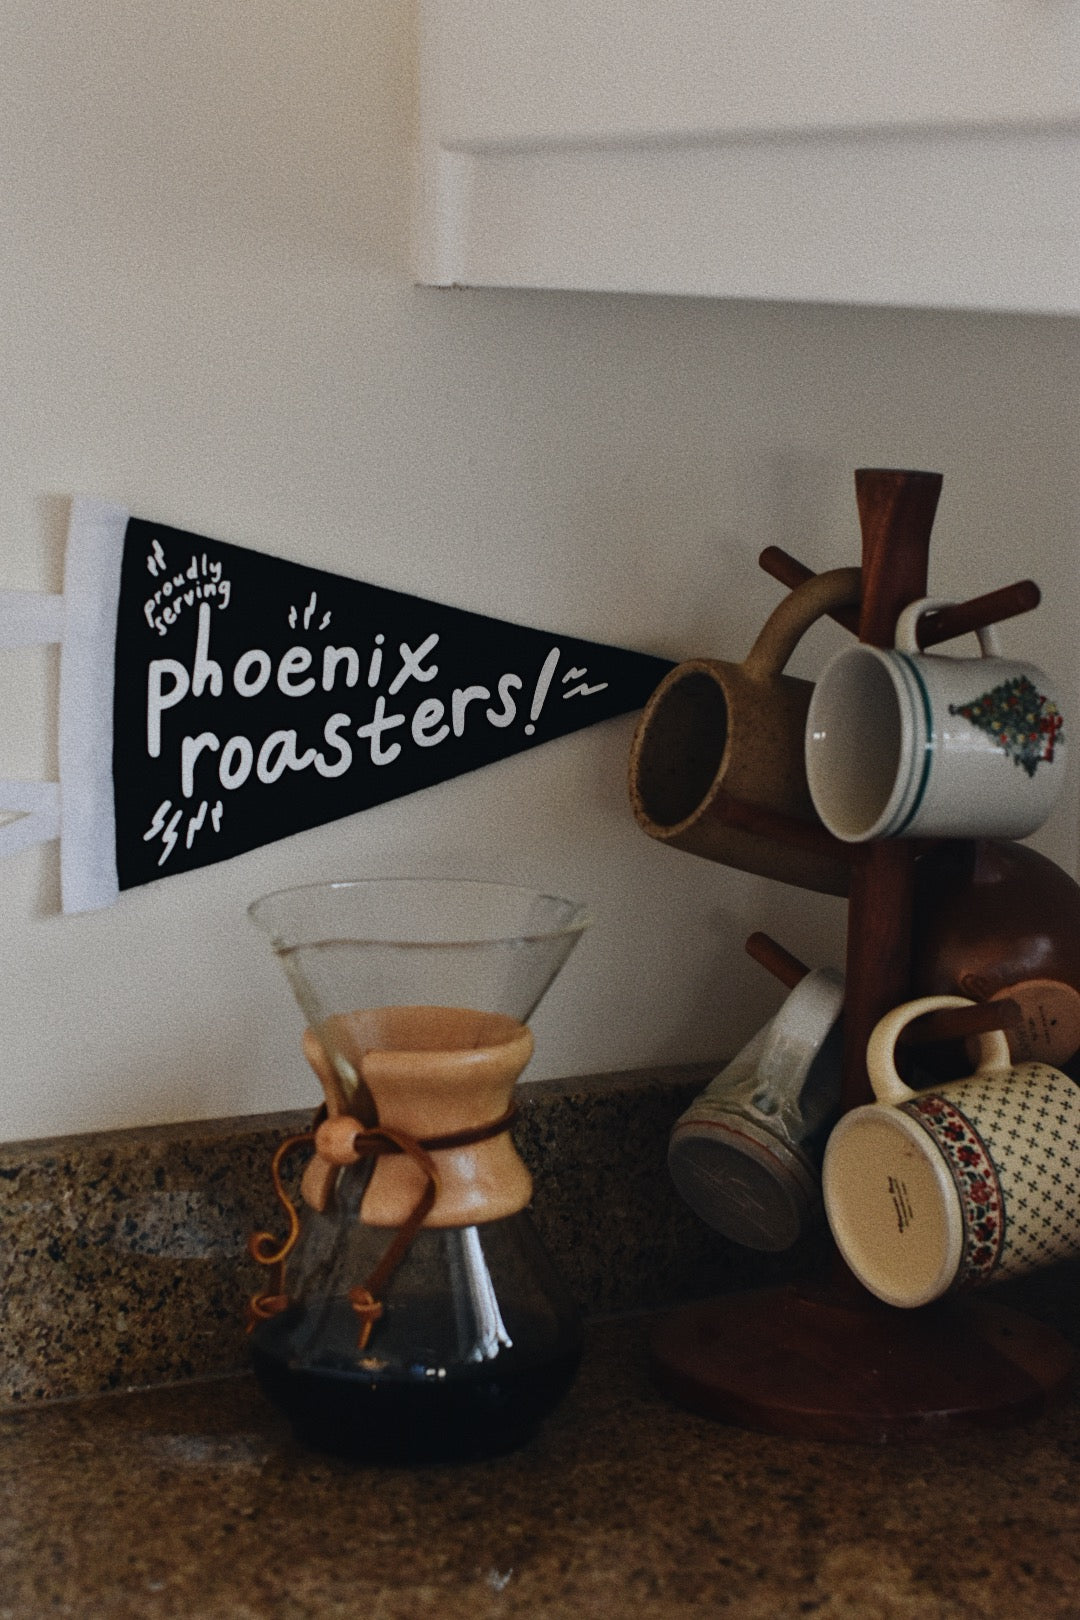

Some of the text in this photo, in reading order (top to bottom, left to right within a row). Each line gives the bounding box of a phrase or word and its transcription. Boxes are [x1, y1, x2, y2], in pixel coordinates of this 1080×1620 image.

[144, 553, 221, 628] proudly
[155, 580, 231, 636] serving
[148, 602, 439, 758] phoenix
[182, 647, 560, 798] roasters!
